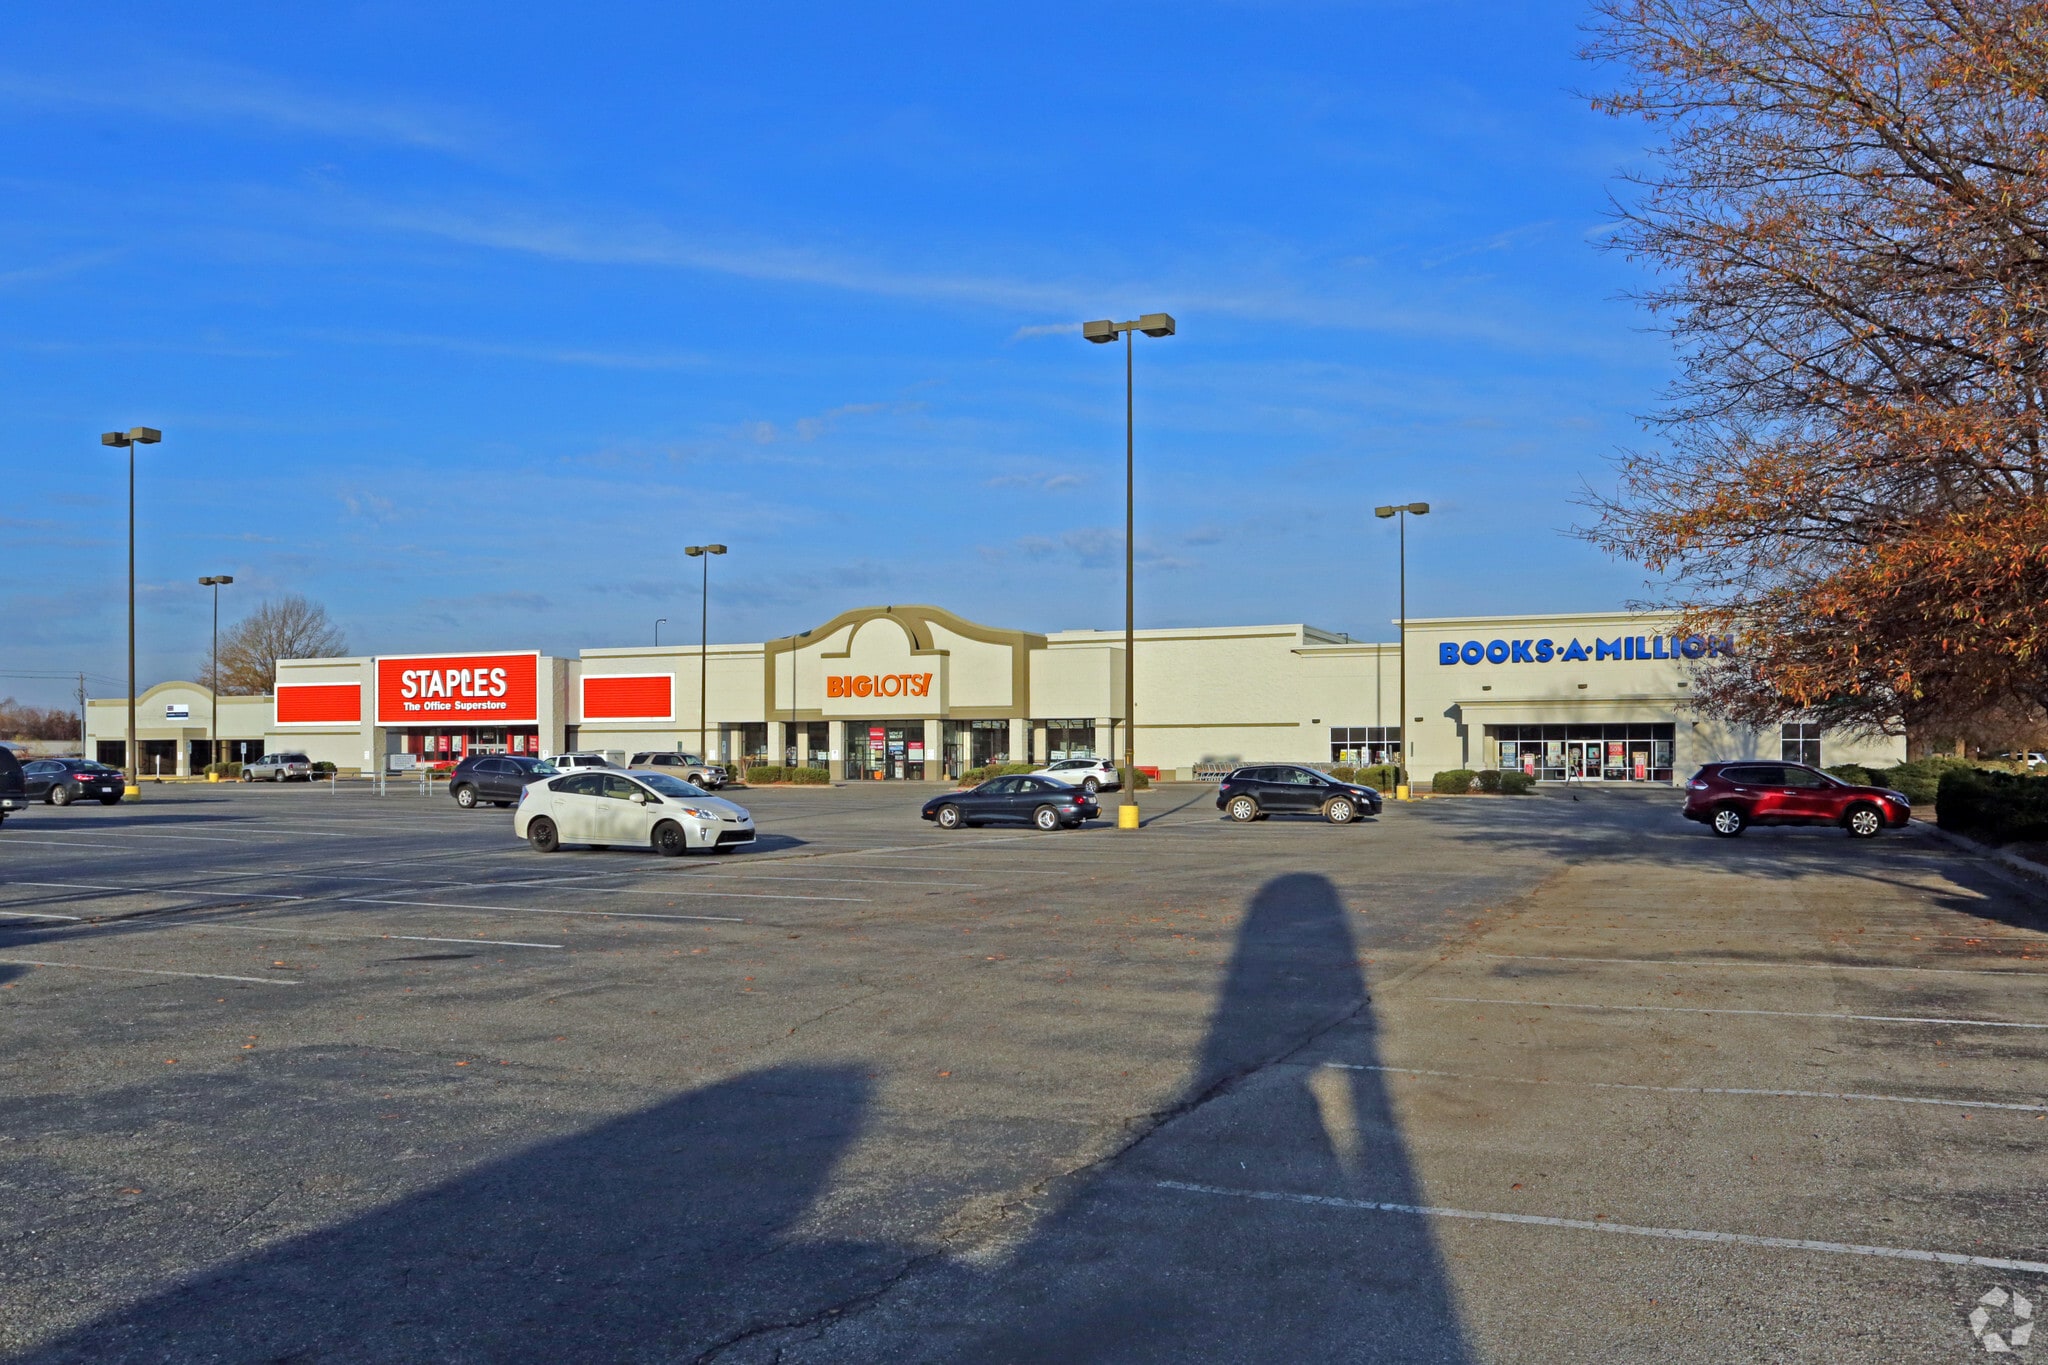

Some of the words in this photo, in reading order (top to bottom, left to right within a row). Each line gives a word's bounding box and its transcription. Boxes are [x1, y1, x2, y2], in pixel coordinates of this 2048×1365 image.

[401, 668, 507, 699] STAPLES
[403, 702, 421, 711] The
[424, 701, 451, 711] Office
[454, 700, 507, 712] Superstore
